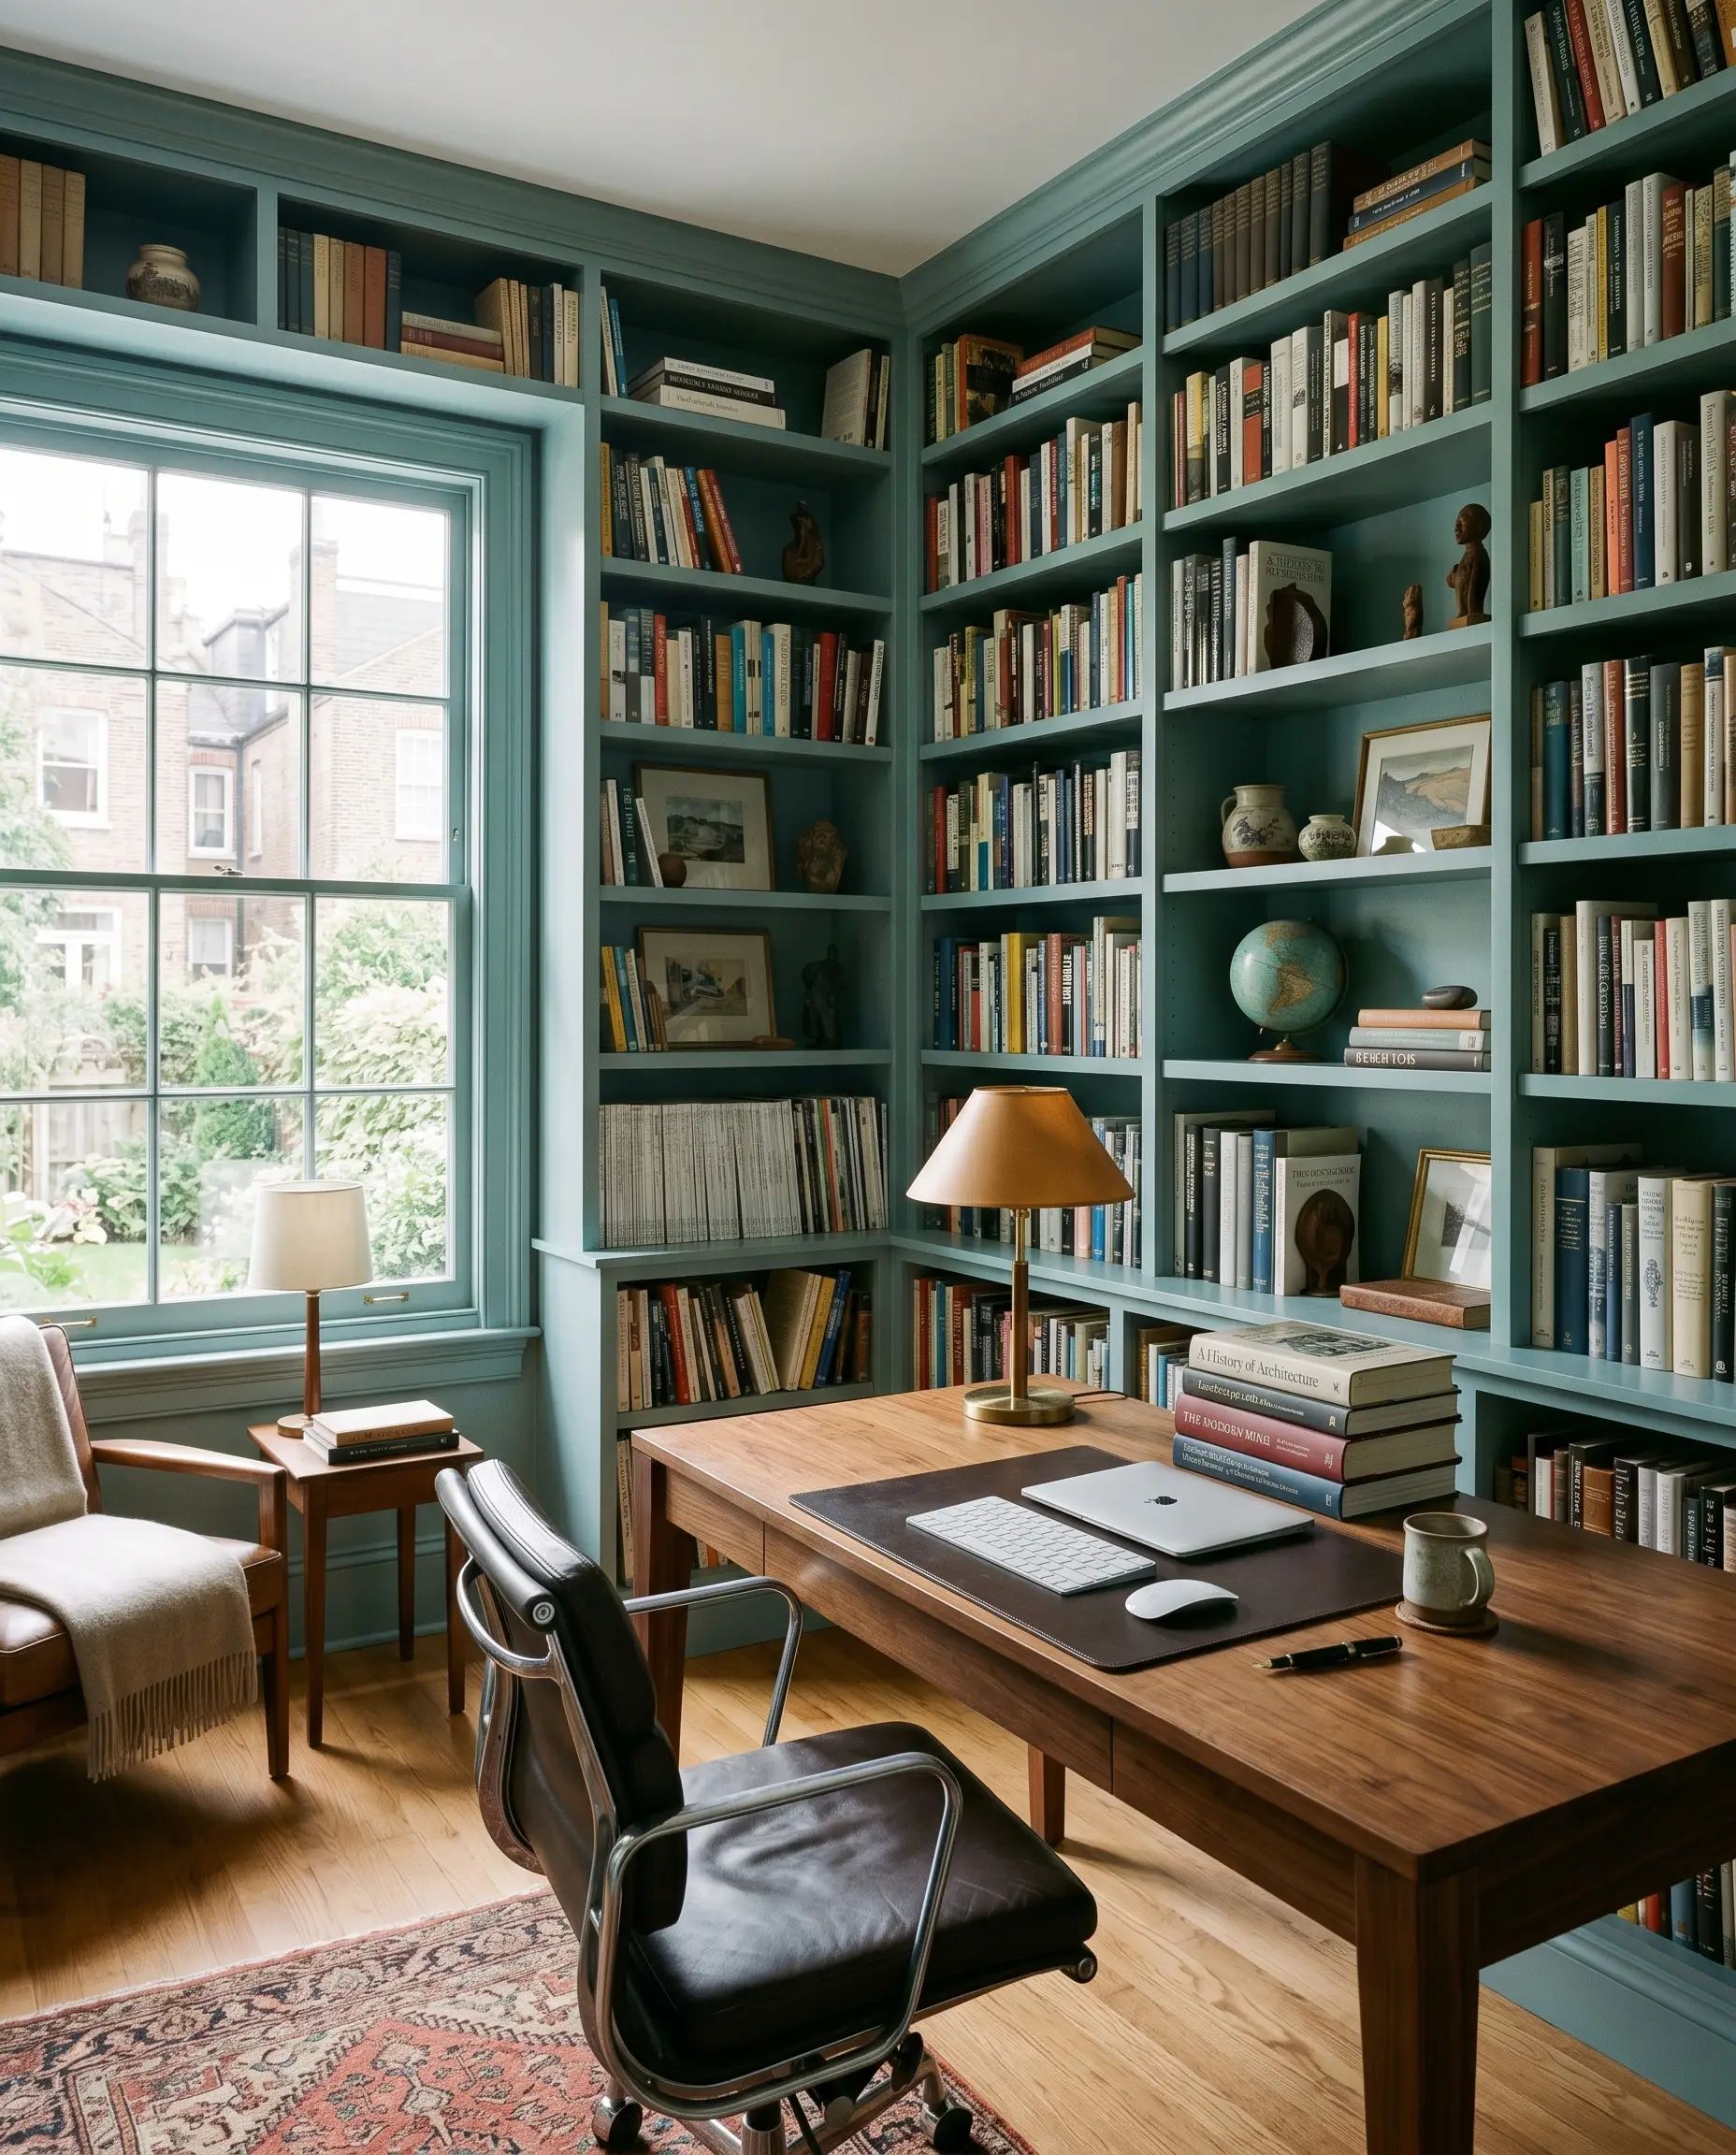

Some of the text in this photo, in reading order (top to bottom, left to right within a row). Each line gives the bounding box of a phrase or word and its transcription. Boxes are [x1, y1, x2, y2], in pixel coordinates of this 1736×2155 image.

[1197, 1347, 1205, 1360] A
[1207, 1349, 1243, 1373] History
[1245, 1359, 1256, 1372] of
[1183, 1410, 1201, 1425] THE
